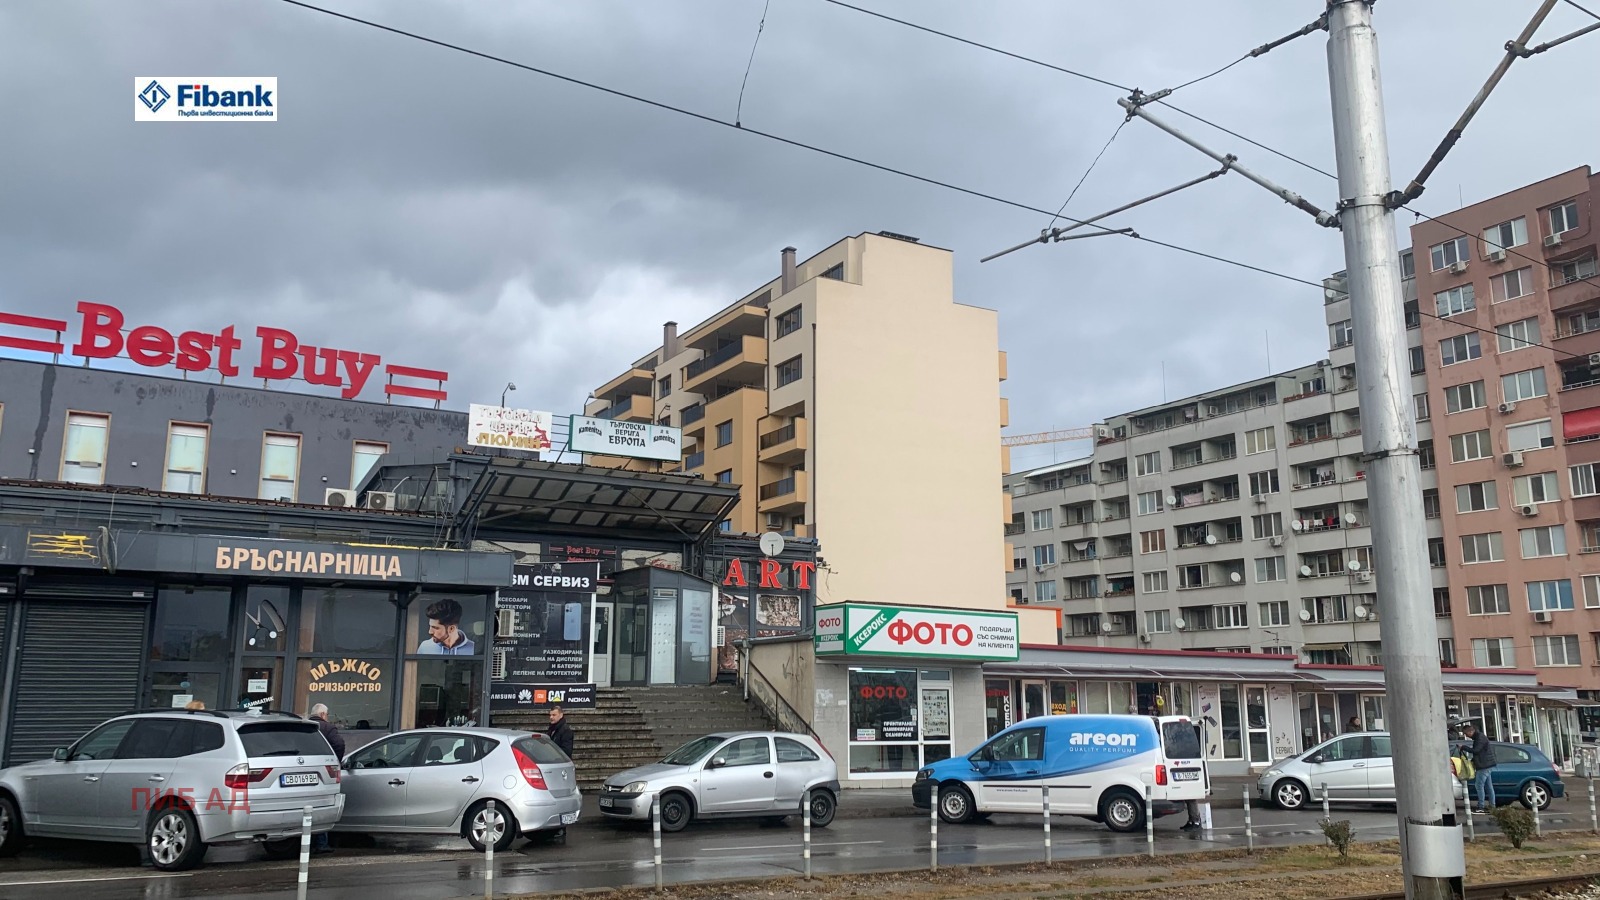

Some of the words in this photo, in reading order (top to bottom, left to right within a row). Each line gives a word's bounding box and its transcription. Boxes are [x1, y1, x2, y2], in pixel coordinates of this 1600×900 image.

[72, 301, 242, 377] Best
[253, 325, 381, 399] Buy
[610, 421, 646, 431] ТЪРГОВСКА
[615, 429, 640, 438] ВЕРИГА
[608, 435, 646, 447] ЕВРОПА
[566, 546, 582, 554] Best
[585, 547, 600, 555] Buy
[215, 546, 402, 579] БРЪСНАРНИЦА
[512, 574, 529, 586] SM
[533, 576, 590, 588] СЕРВИЗ
[722, 558, 816, 590] ART
[819, 618, 840, 628] ФОТО
[854, 613, 887, 646] КСЕРОКС
[887, 619, 973, 646] ФОТО
[309, 658, 381, 681] МЪЖКО
[309, 682, 382, 692] ФРИЗЬОРСТВО
[861, 685, 908, 700] ФОТО
[243, 696, 274, 708] КЛИМАТИК
[548, 690, 566, 702] CAT
[1003, 695, 1011, 729] КСЕР
[1069, 732, 1137, 746] areon
